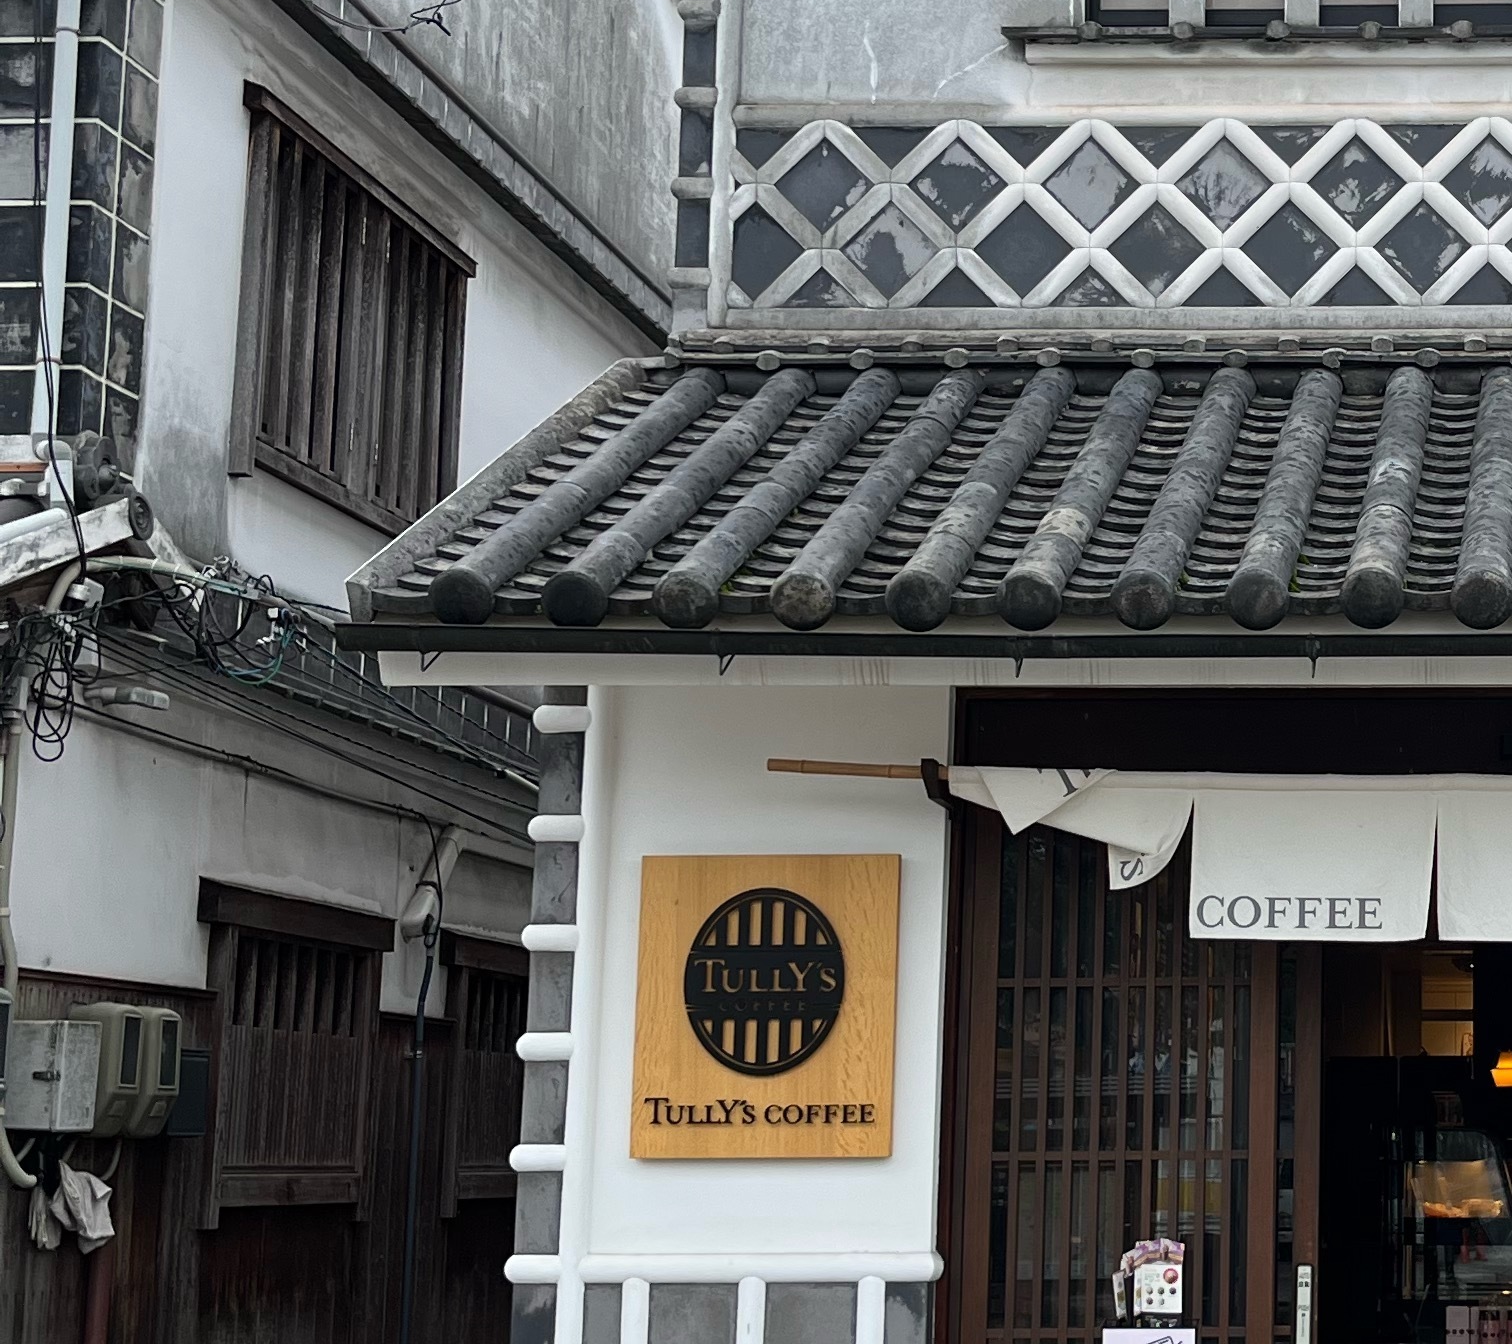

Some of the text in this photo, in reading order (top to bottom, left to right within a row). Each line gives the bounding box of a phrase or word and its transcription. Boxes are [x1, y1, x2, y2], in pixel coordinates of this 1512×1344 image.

[1196, 894, 1383, 930] COFFEE
[694, 959, 837, 993] TULLY'S
[643, 1097, 876, 1125] TULLY'S COFFEE
